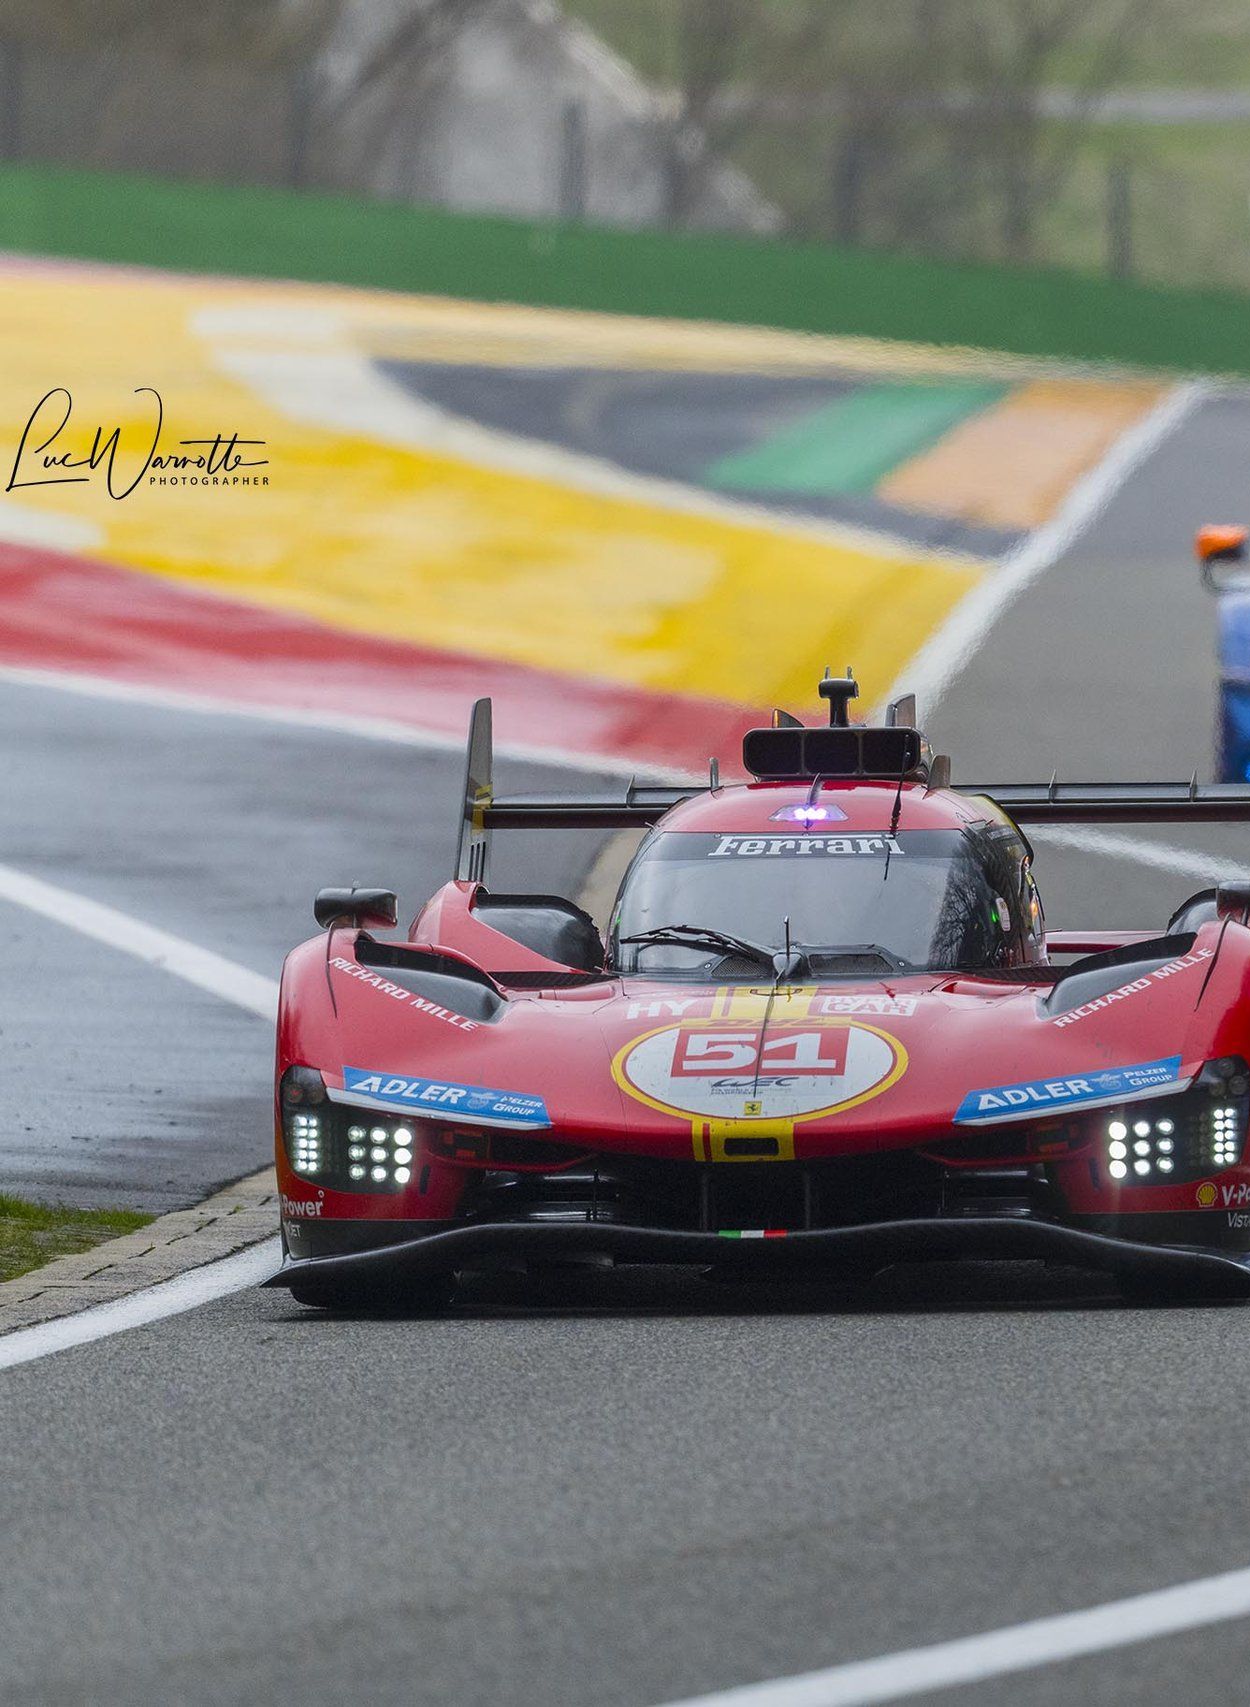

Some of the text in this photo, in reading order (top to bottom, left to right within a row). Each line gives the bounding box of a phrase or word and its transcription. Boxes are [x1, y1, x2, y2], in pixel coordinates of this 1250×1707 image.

[708, 834, 905, 856] Ferrari
[329, 956, 479, 1032] RICHARD MILLE
[1053, 948, 1215, 1028] RICHARD MILLE
[626, 998, 698, 1020] HY
[682, 1033, 838, 1071] 51
[1122, 1066, 1168, 1079] PELZER
[1129, 1073, 1173, 1087] GROUP
[351, 1075, 468, 1104] ADLER
[978, 1077, 1094, 1111] ADLER
[491, 1103, 536, 1116] GROUP
